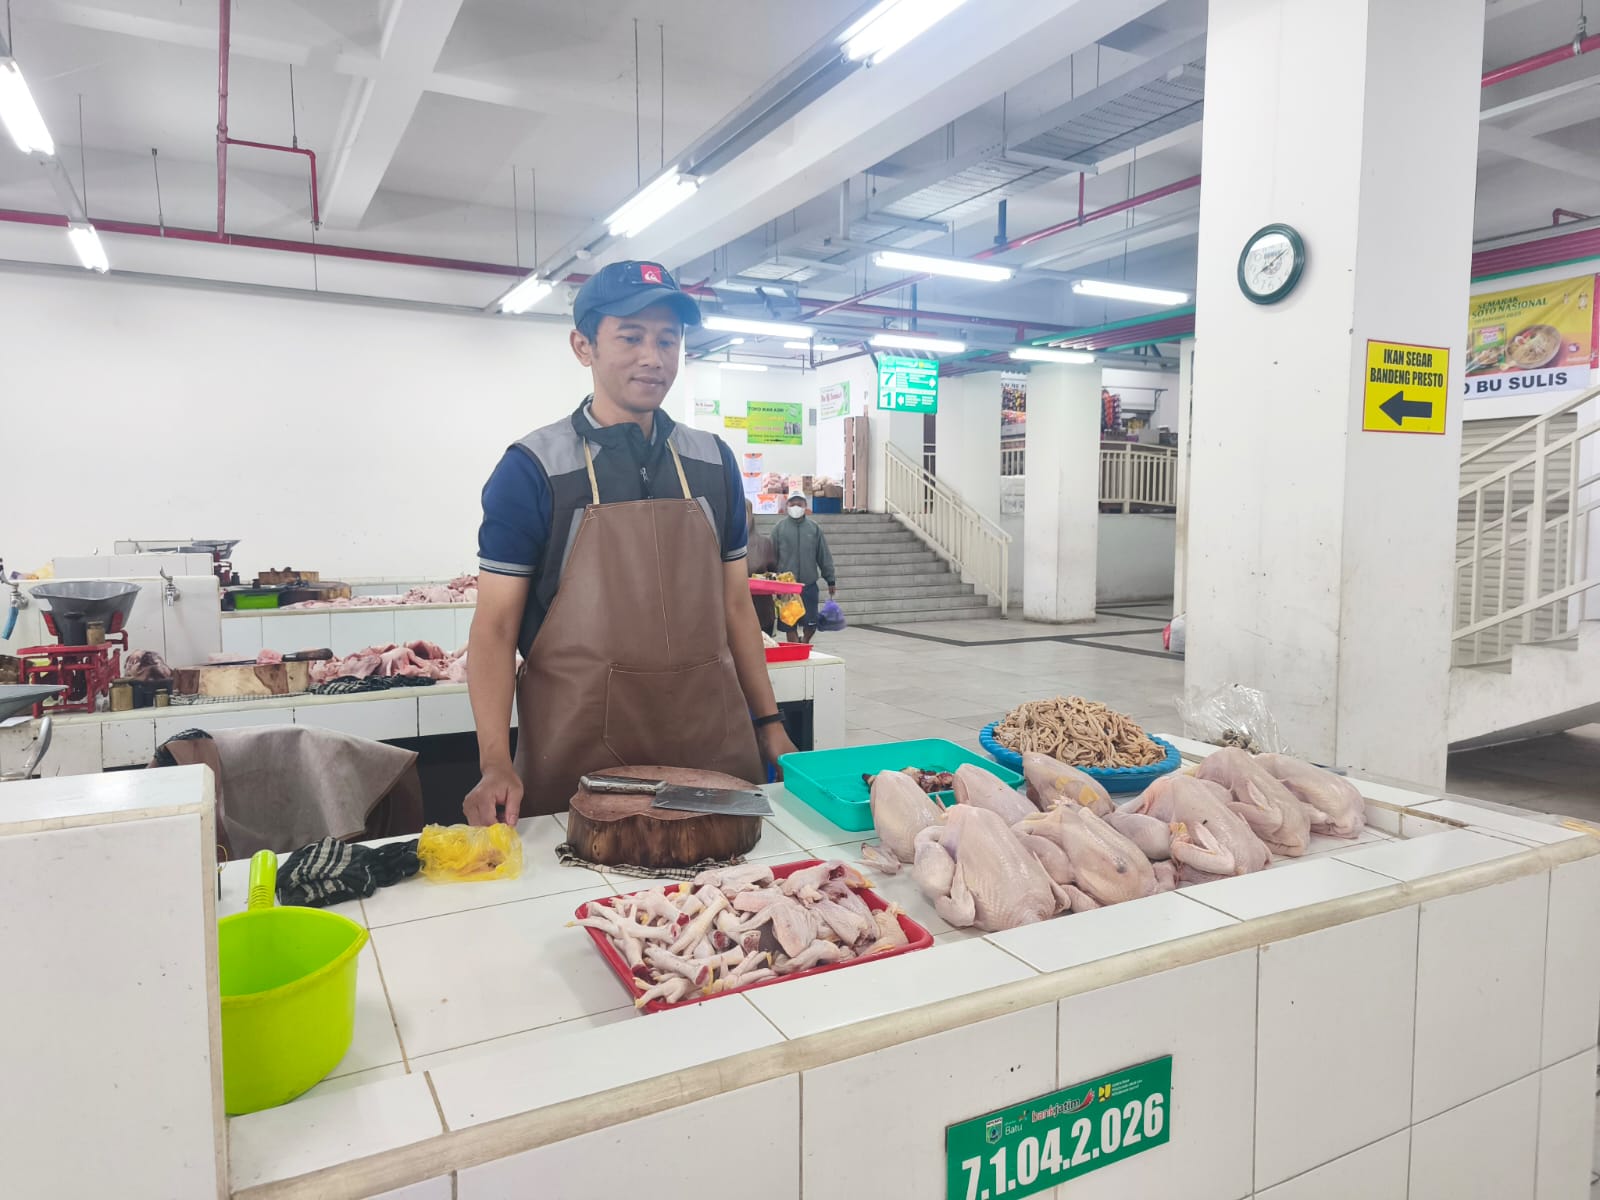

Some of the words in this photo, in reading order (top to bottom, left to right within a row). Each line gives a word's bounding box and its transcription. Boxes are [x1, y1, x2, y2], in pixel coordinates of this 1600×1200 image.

[1472, 307, 1496, 318] SOTO
[1498, 297, 1547, 312] NASIONAL
[1384, 349, 1404, 365] IKAN
[1406, 351, 1433, 368] SEGAR
[1370, 368, 1410, 385] BANDENG
[1412, 371, 1443, 388] PRESTO
[1476, 378, 1502, 394] BU
[1508, 372, 1568, 390] SULIS
[882, 392, 892, 407] 1
[1005, 1124, 1023, 1136] Batu
[962, 1092, 1164, 1200] 7.1.04.2.026
